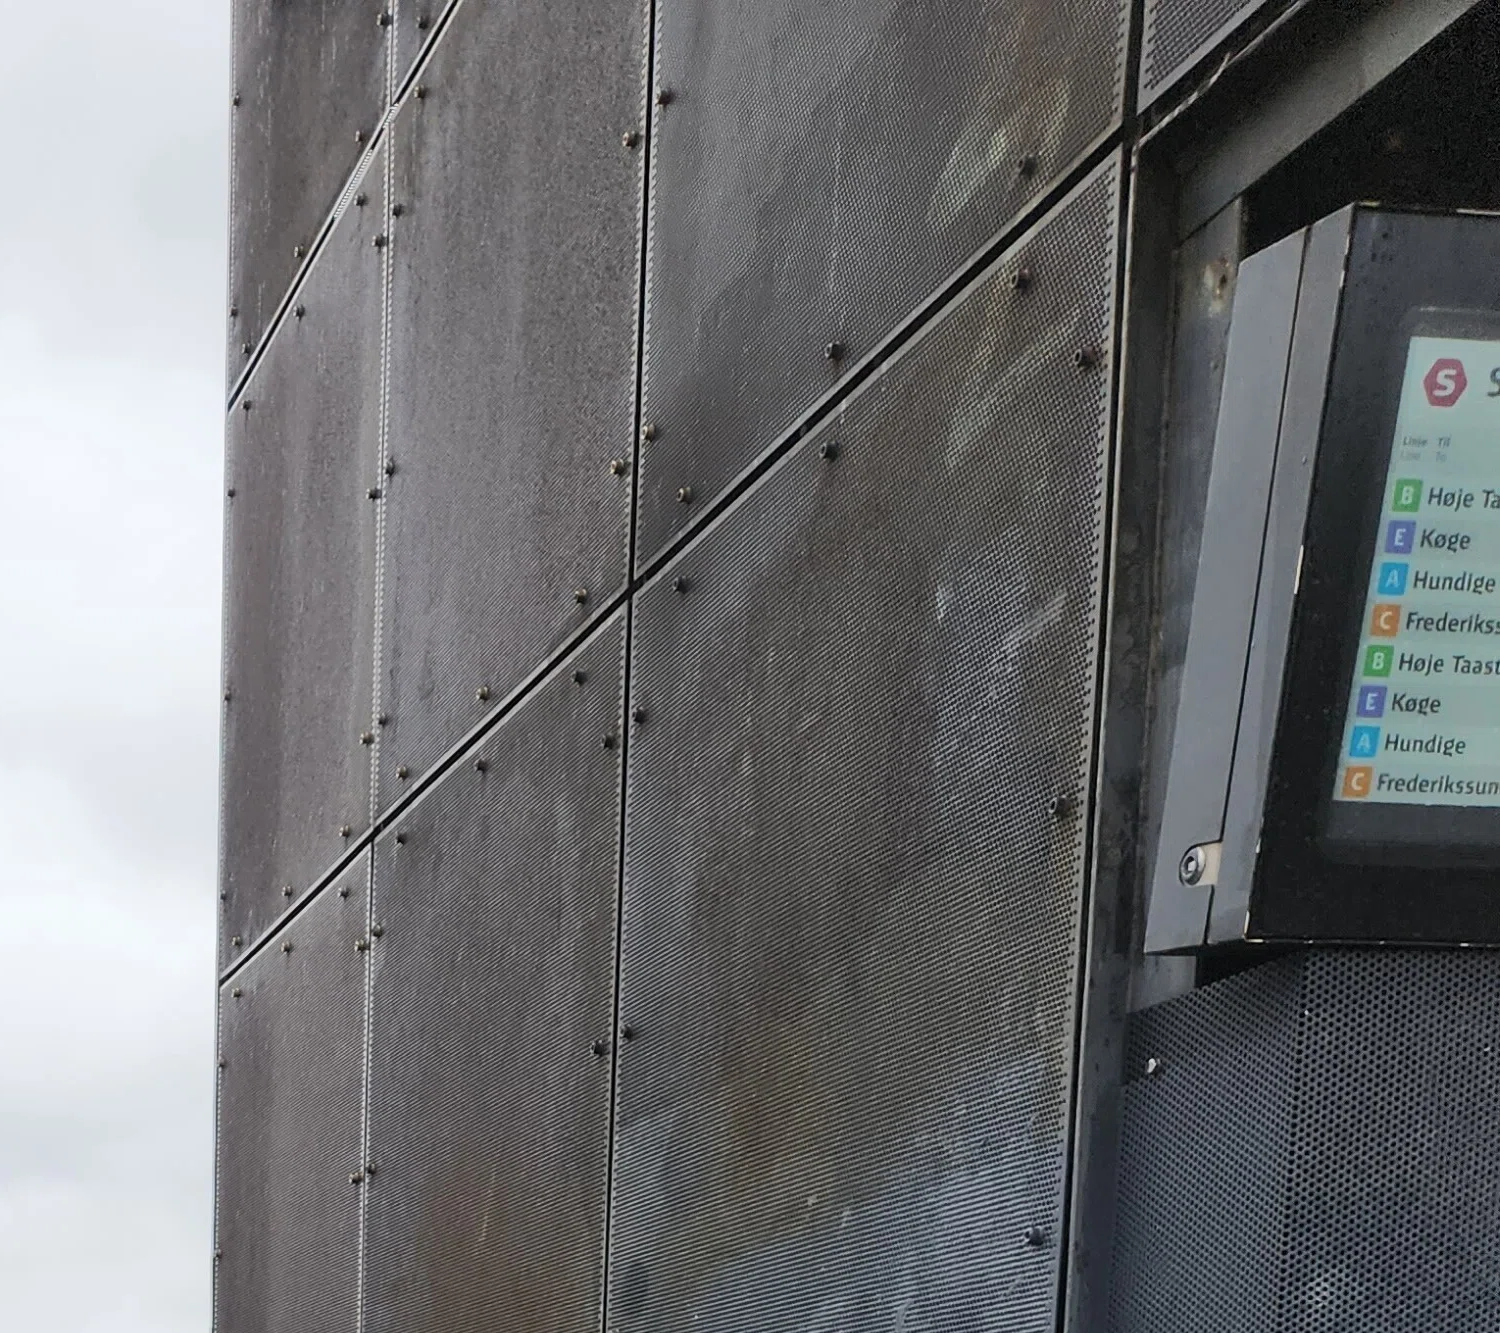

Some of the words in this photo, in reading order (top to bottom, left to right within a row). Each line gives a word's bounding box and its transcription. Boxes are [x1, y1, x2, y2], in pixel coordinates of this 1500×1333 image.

[1432, 368, 1457, 397] S
[1401, 486, 1414, 505] B
[1427, 486, 1475, 512] Høje
[1394, 528, 1407, 546] E
[1420, 528, 1471, 553] Køge
[1385, 569, 1401, 588] A
[1413, 570, 1496, 595] Hundige
[1379, 611, 1393, 630] C
[1372, 651, 1385, 671] B
[1398, 652, 1444, 674] Høje
[1365, 692, 1379, 711] E
[1391, 692, 1441, 716] Køge
[1357, 733, 1371, 752] A
[1384, 733, 1467, 757] Hundige
[1351, 772, 1365, 791] C
